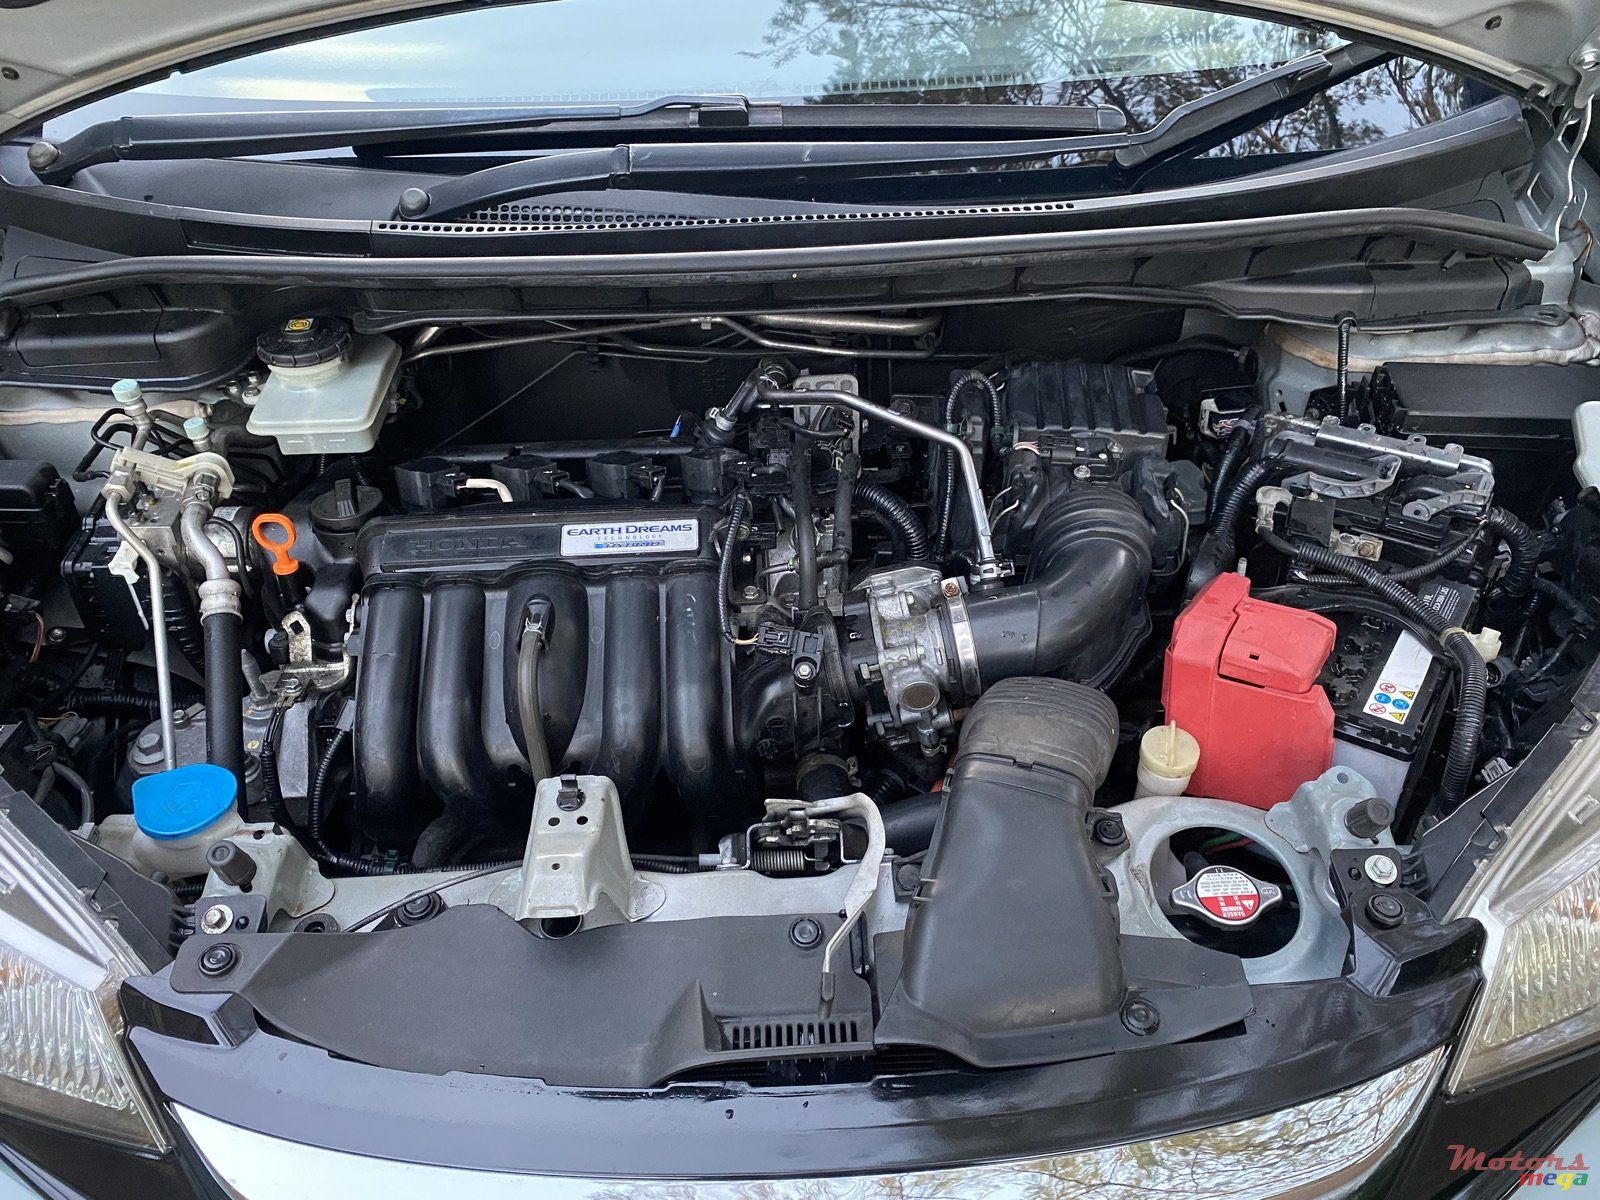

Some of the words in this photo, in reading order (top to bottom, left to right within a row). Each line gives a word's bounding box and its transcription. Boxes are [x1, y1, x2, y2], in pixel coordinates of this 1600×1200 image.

[567, 527, 622, 537] EARTH
[625, 523, 693, 534] DREAMS
[408, 536, 527, 552] HONDA
[605, 541, 660, 549] HYBRID
